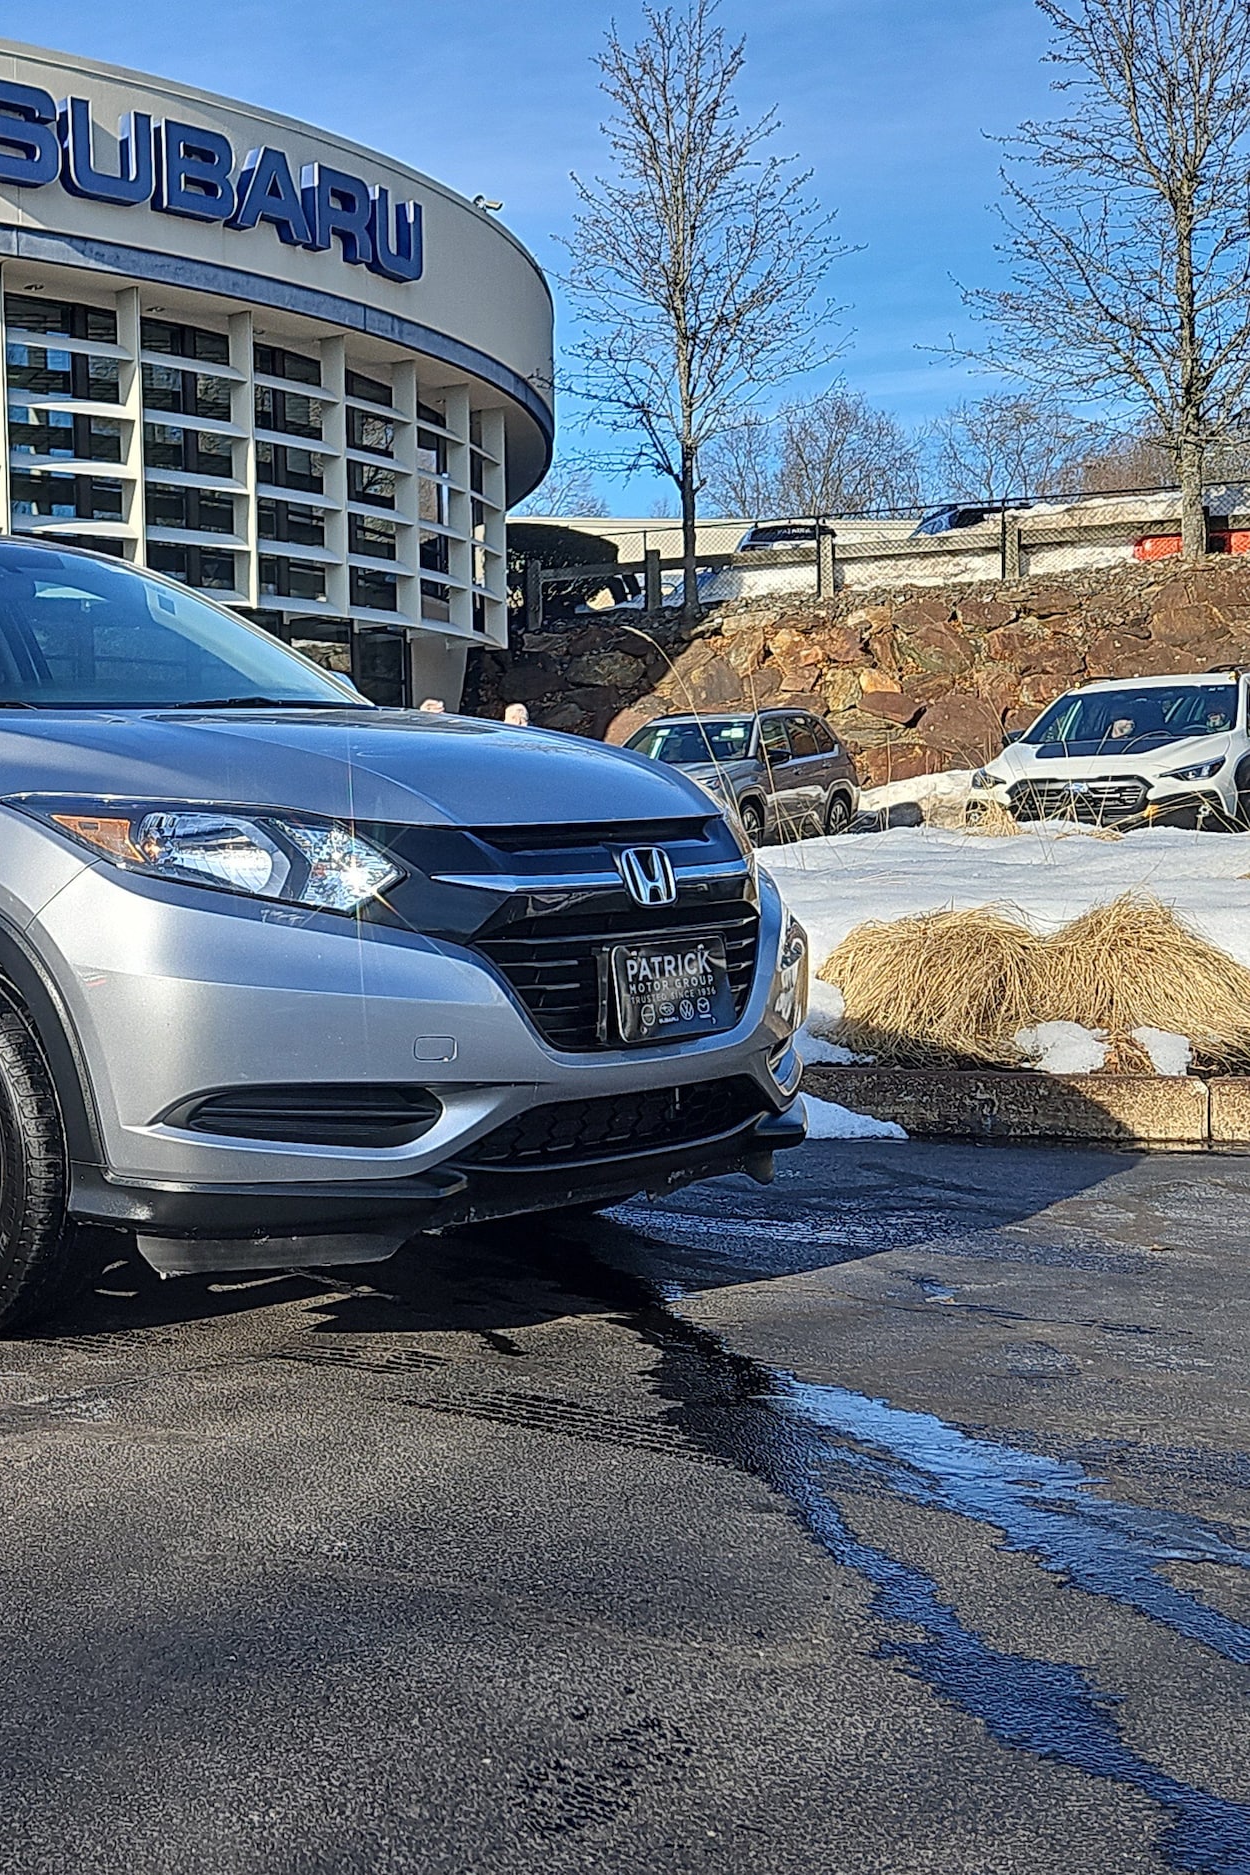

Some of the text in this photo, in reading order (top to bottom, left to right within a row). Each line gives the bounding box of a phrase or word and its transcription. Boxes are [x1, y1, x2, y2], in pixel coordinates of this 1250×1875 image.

[626, 950, 712, 982] PATRICK
[629, 974, 714, 995] MOTOR GROUP
[630, 986, 717, 1004] TRUSTED SINCE 1936
